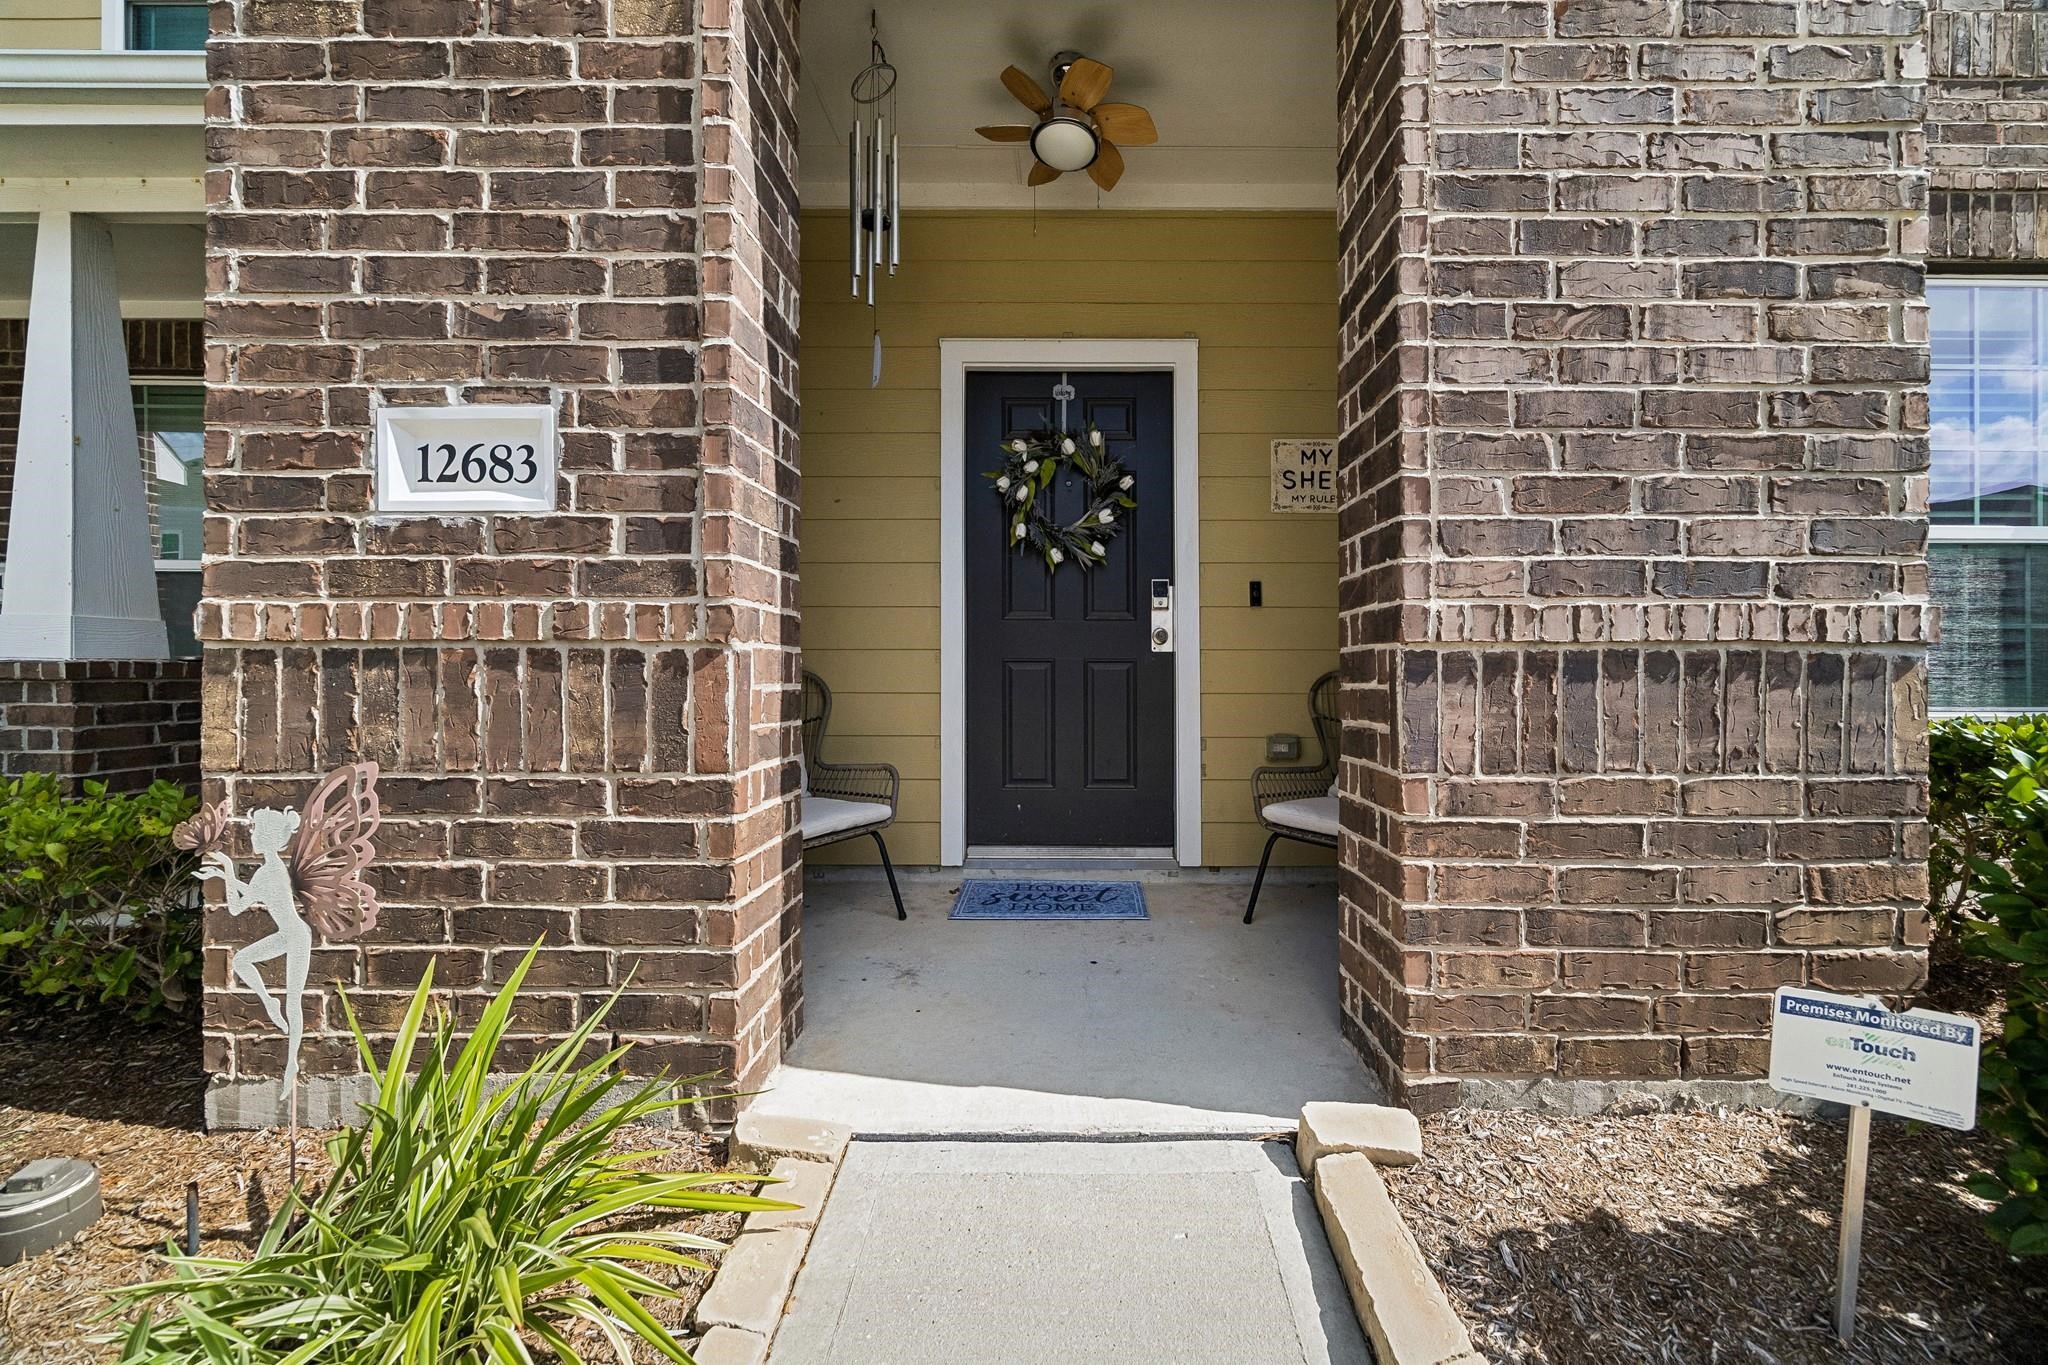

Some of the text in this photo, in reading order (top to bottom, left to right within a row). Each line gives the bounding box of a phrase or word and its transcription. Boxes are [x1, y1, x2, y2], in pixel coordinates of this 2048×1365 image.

[417, 443, 538, 484] 12683
[1301, 449, 1333, 466] MY
[1283, 470, 1338, 490] SHE
[1292, 495, 1307, 503] MY
[981, 886, 1119, 906] sweet
[1015, 883, 1094, 893] HOME
[1009, 903, 1094, 912] HOME
[1786, 999, 1967, 1042] Premises Monitored By
[1824, 1036, 1916, 1062] enTouch
[1825, 1063, 1912, 1085] www.entouch.net
[1832, 1072, 1903, 1091] EnTouch Alarm Systems
